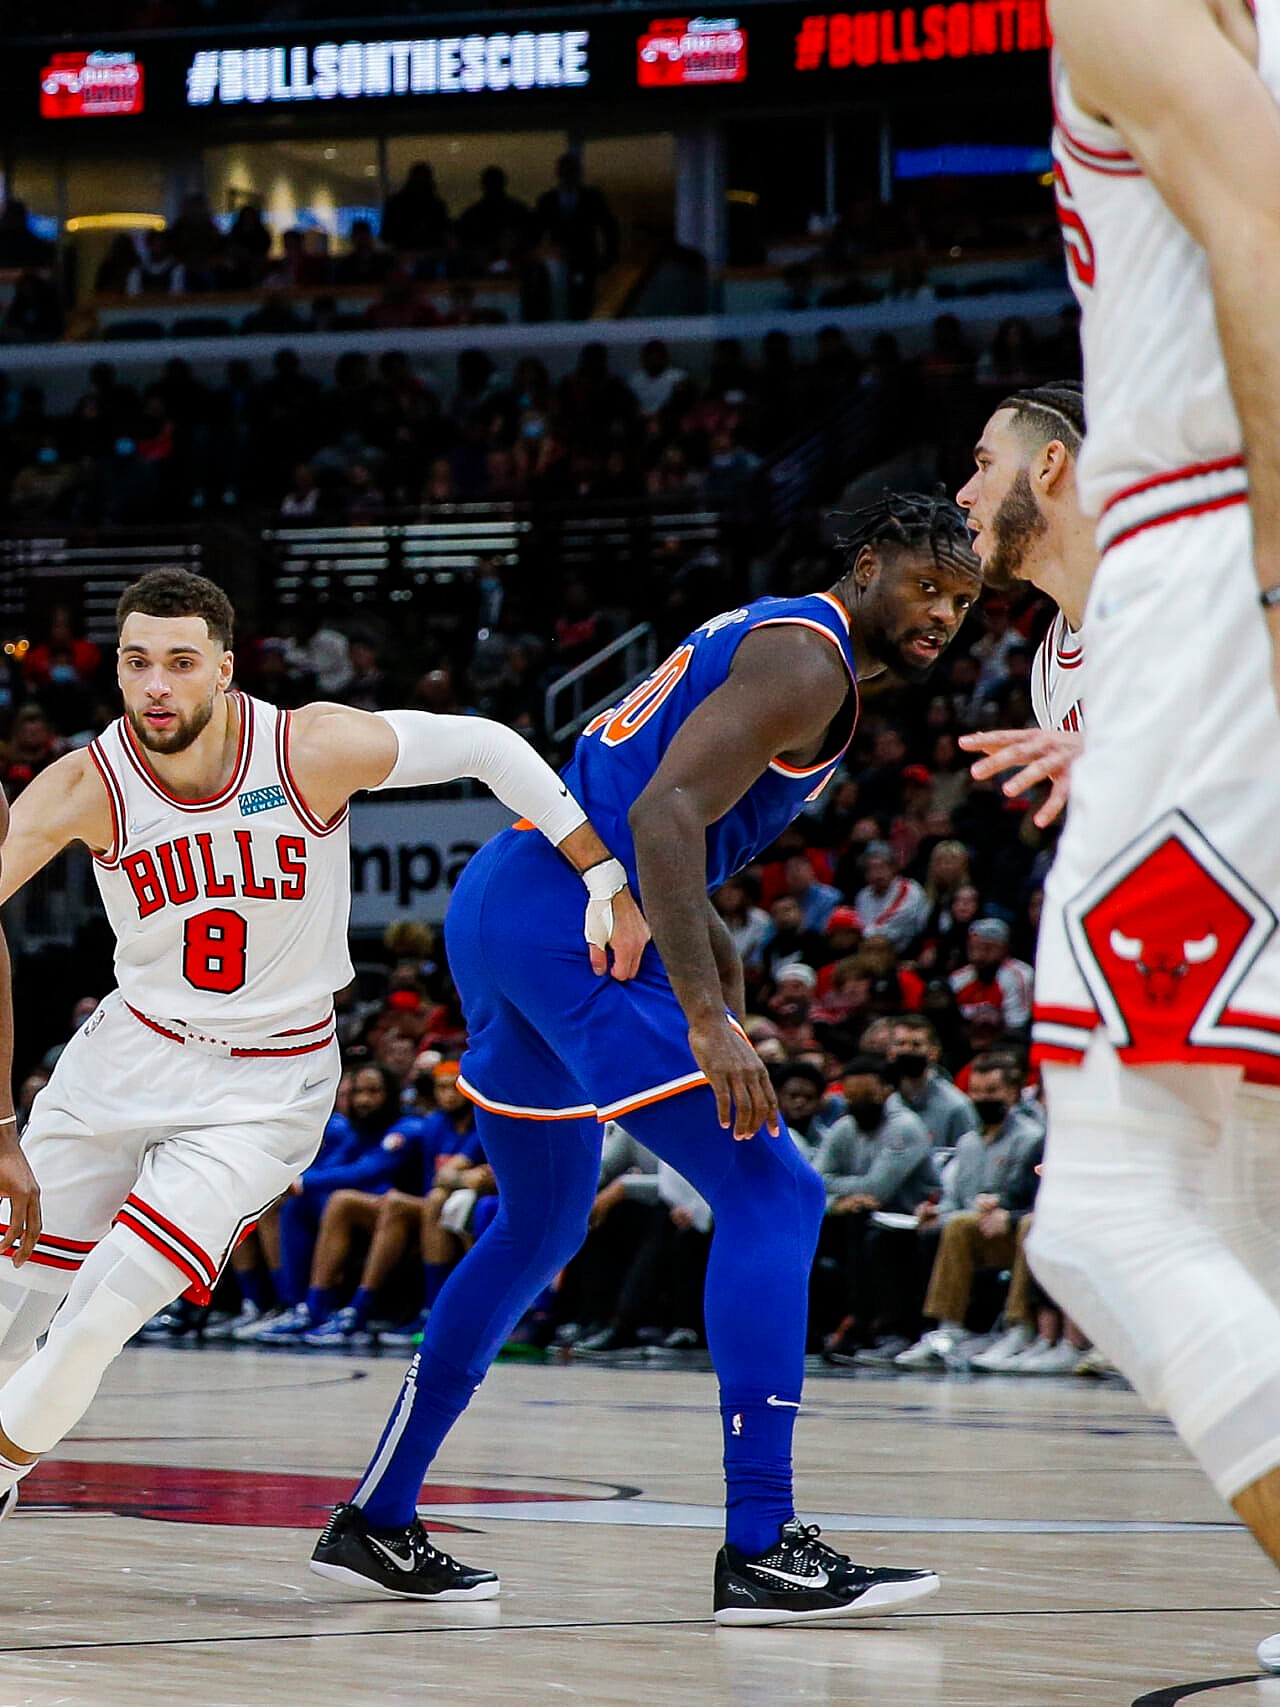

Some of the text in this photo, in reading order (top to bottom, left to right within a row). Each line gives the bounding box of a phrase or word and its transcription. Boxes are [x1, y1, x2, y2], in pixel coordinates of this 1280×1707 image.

[186, 30, 590, 106] #BULLSONTHESCORE
[120, 830, 307, 920] BULLS
[182, 907, 248, 995] 8
